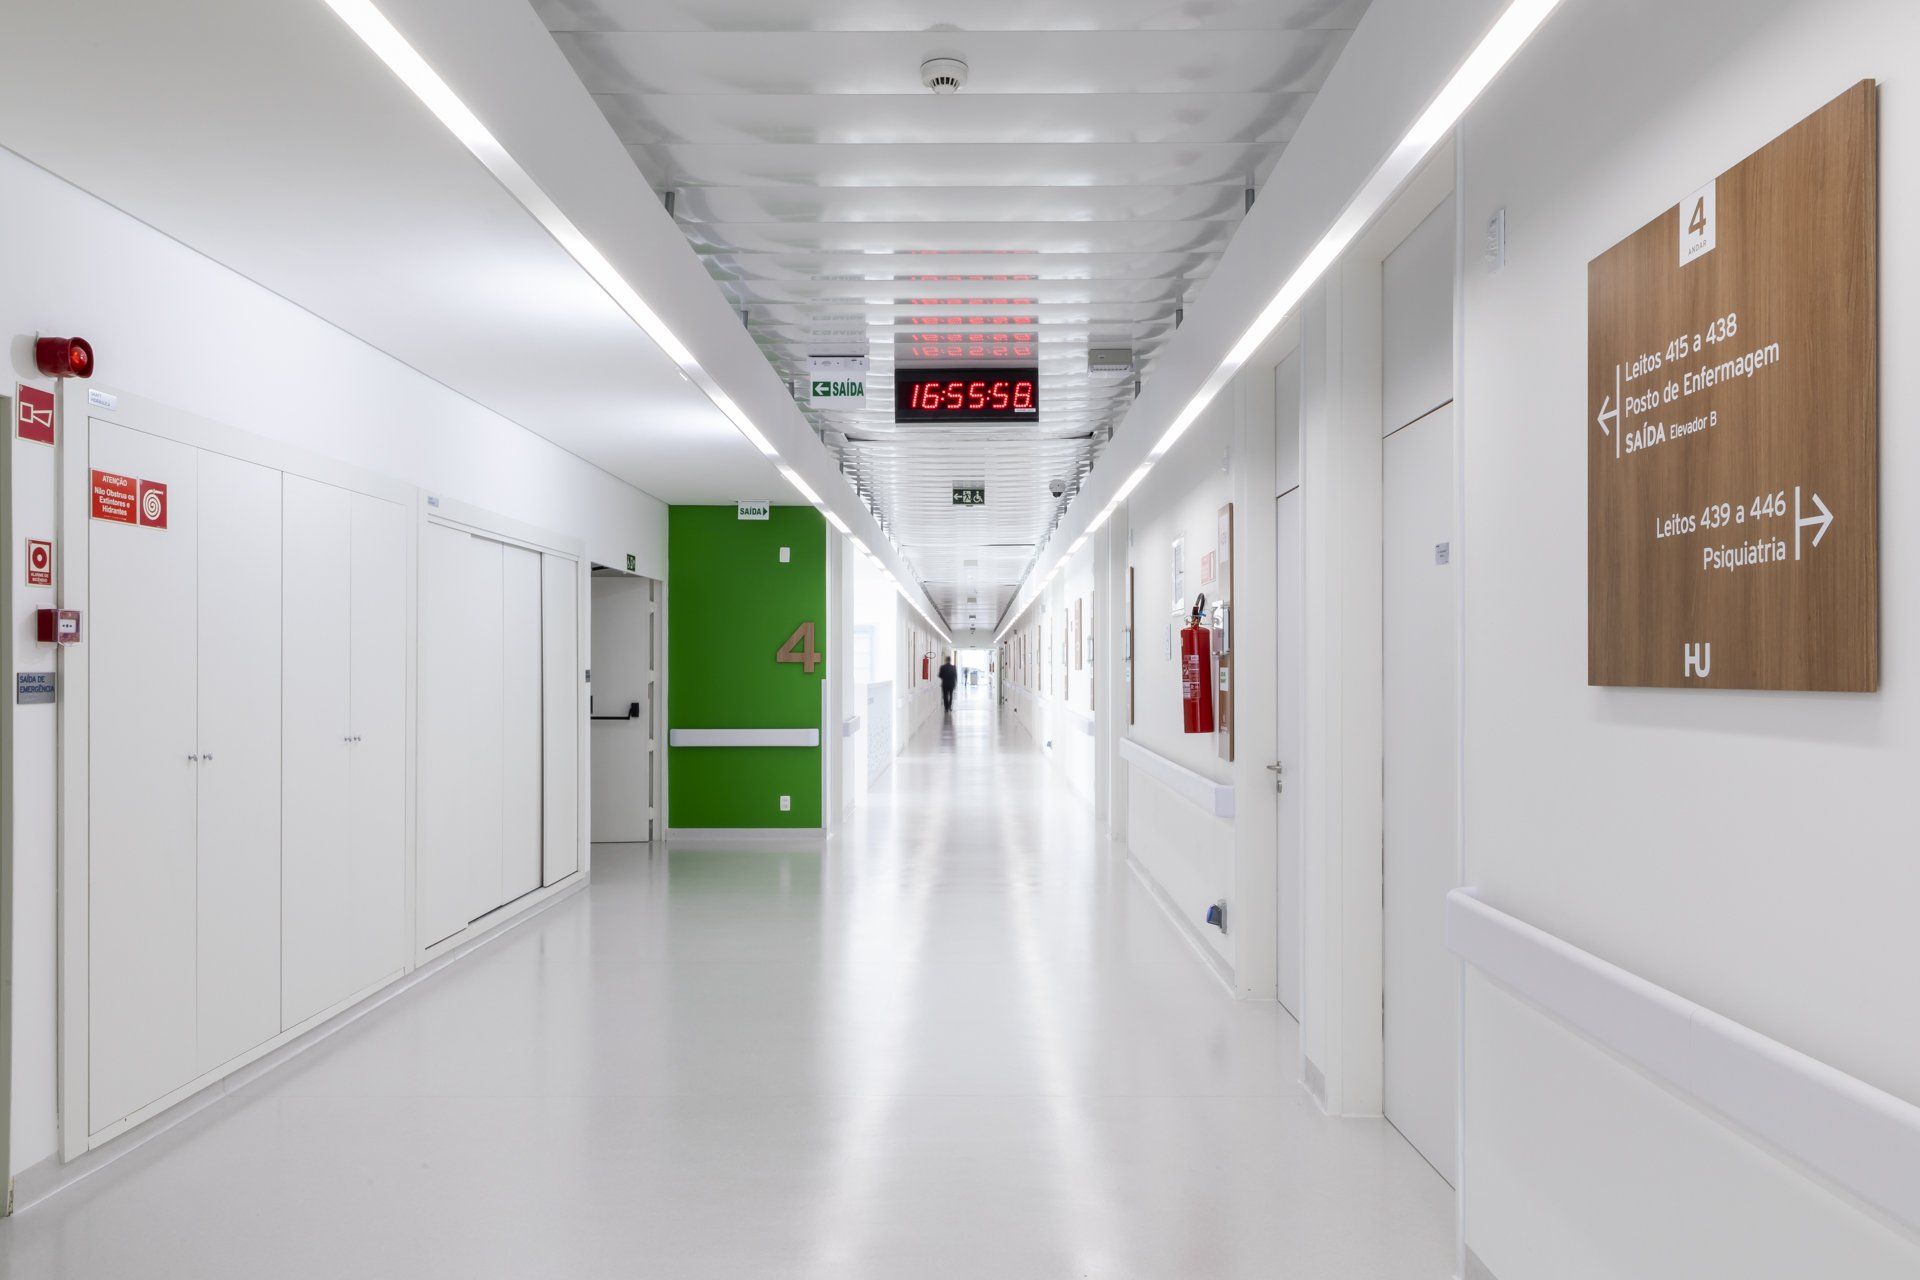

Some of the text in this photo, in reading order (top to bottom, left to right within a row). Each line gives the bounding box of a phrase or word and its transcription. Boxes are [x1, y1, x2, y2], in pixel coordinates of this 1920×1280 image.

[1688, 196, 1706, 236] 4
[1688, 240, 1707, 256] ANDAR
[1625, 313, 1737, 382] Leitos 415 a 438
[832, 378, 864, 397] SAÍDA
[1625, 342, 1780, 418] Posto de Enfermagem
[1625, 411, 1717, 454] SAÍDA Elevador B
[102, 475, 127, 487] ATENÇÃO
[94, 486, 105, 495] Não
[106, 488, 127, 500] Obstrua
[99, 496, 126, 508] Extintores
[102, 504, 127, 516] Hidrantes
[740, 506, 761, 515] SAÍDA
[1656, 490, 1786, 539] Leitos 439 a 446
[1703, 536, 1786, 572] Psiquiatria
[777, 622, 821, 673] 4
[1684, 642, 1711, 678] HU
[20, 674, 46, 684] SAÍDA DE
[20, 684, 55, 694] EMERGÊNCIA
